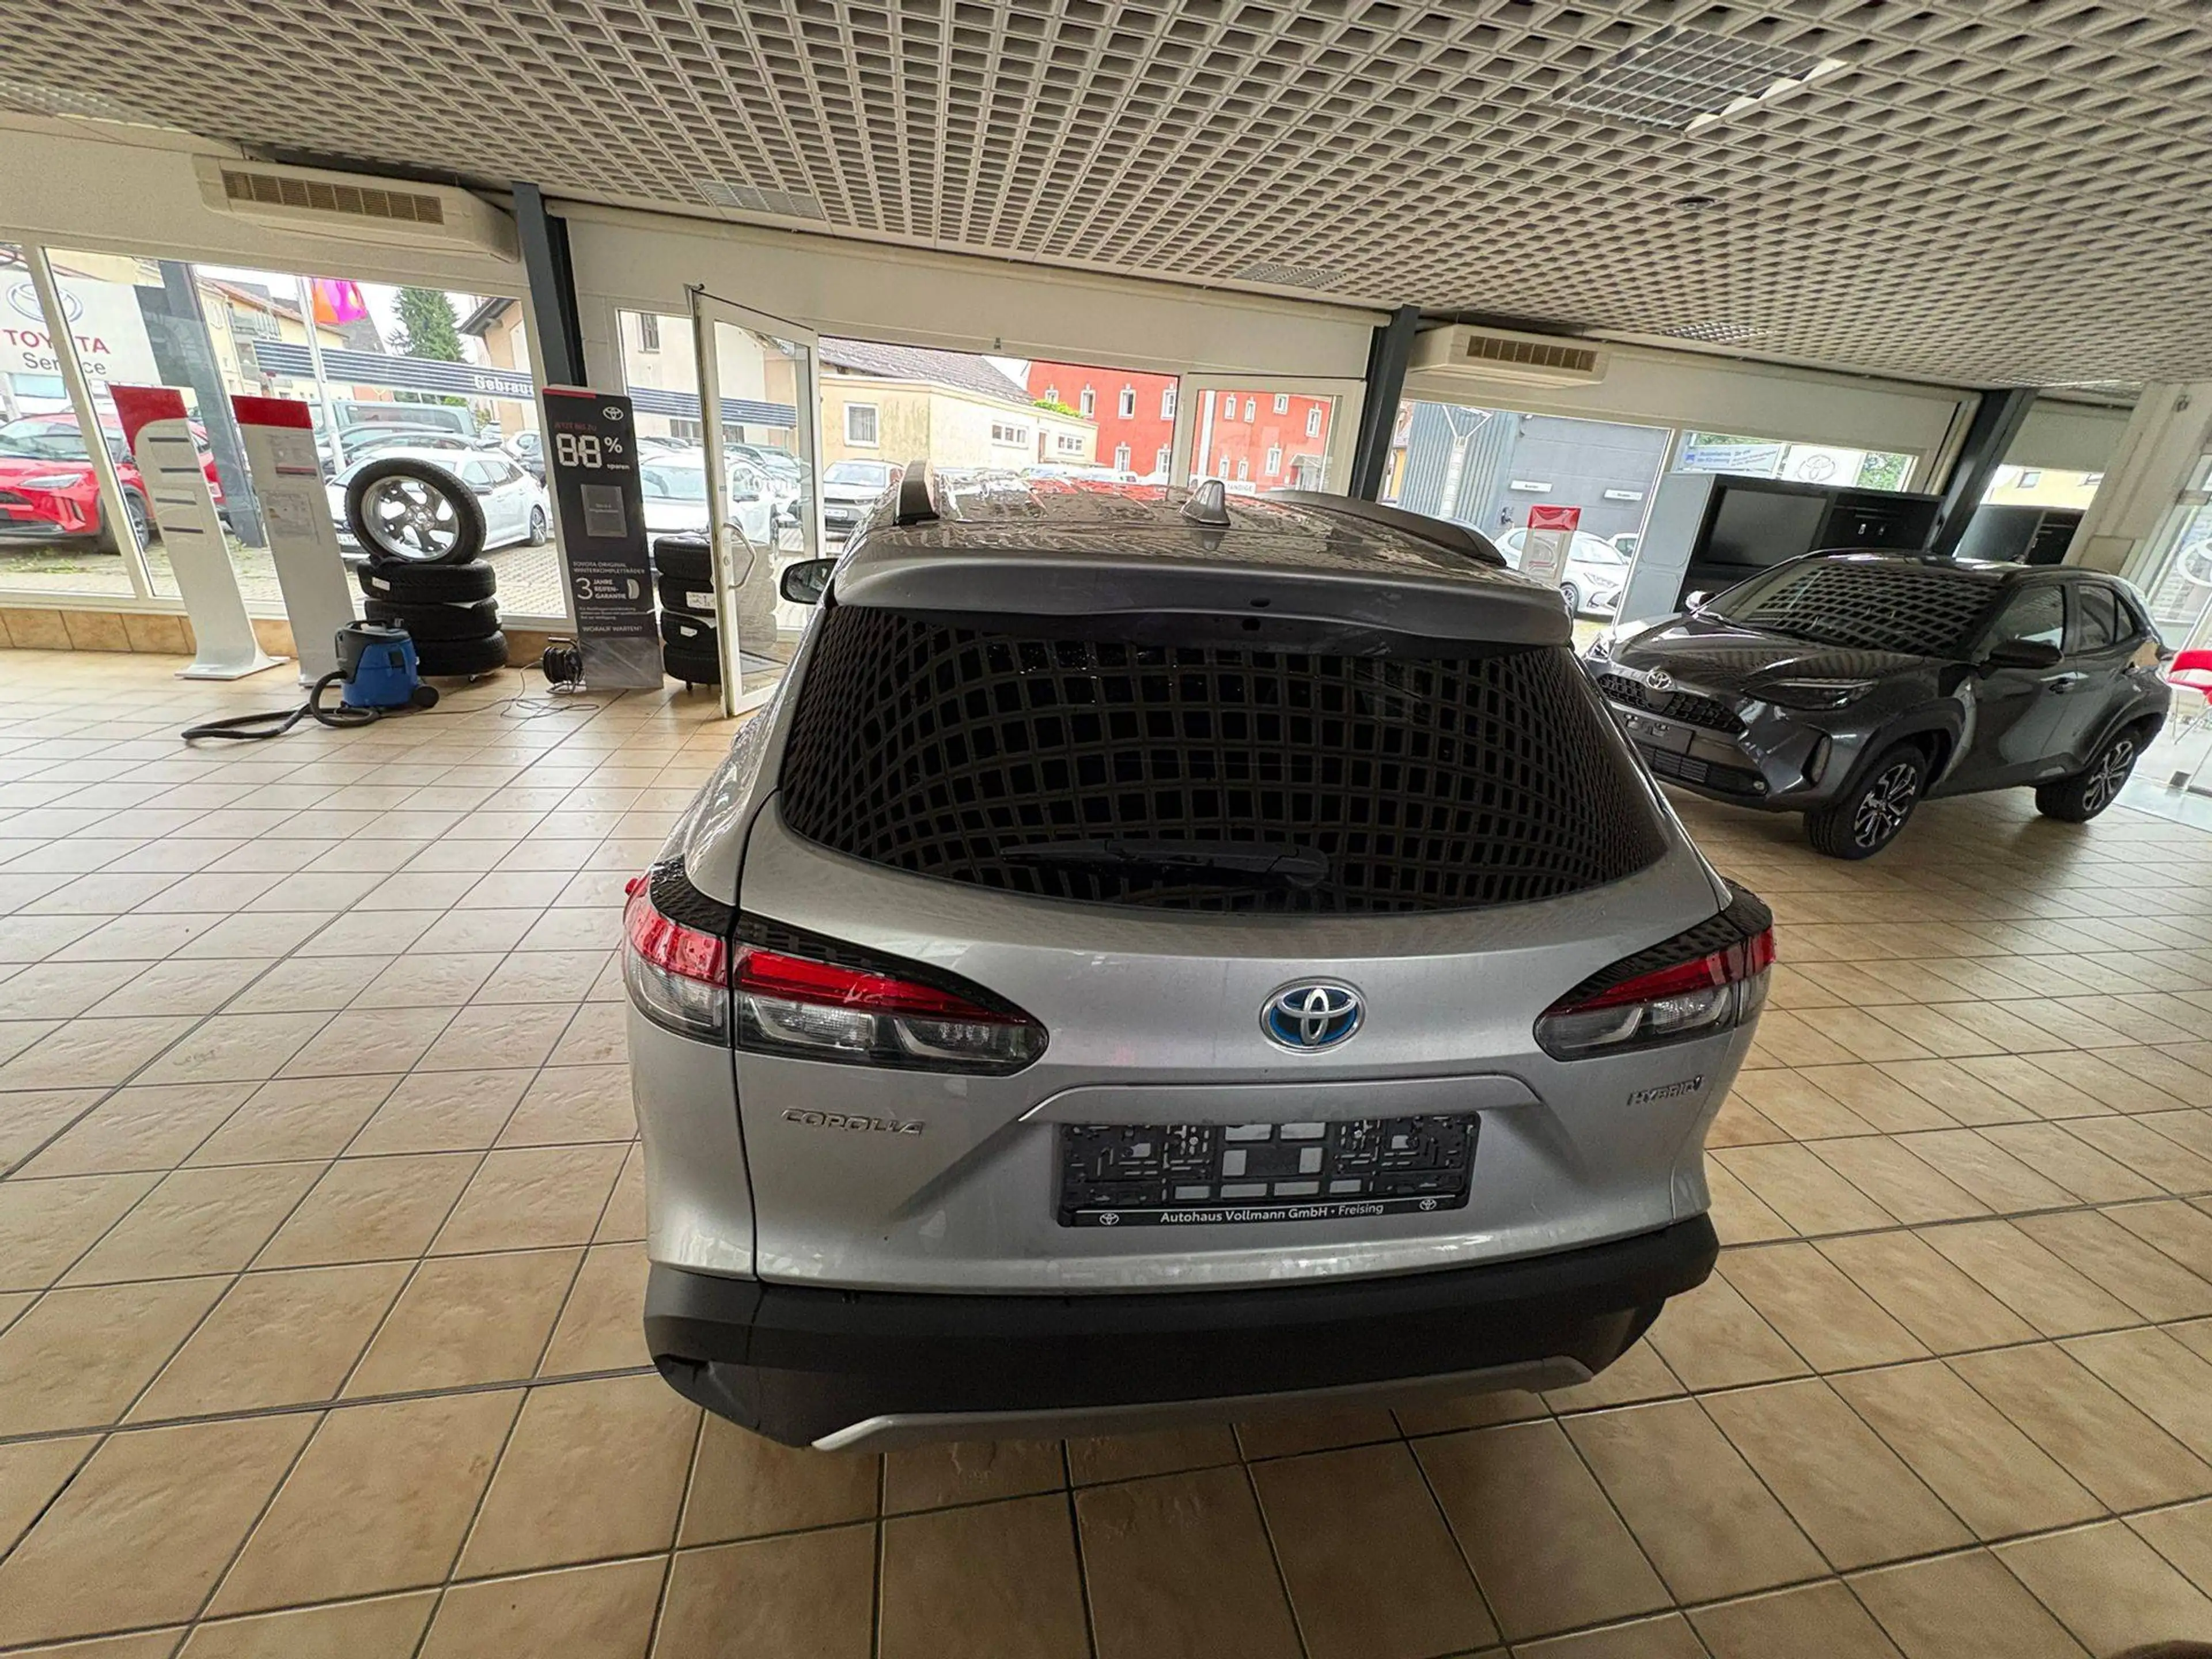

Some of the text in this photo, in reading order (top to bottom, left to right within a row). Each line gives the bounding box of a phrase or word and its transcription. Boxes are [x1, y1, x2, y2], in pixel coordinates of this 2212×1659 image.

[2, 329, 111, 354] TOYTA
[22, 351, 107, 374] Serce
[556, 433, 623, 468] 88 %
[575, 577, 593, 599] 3
[781, 1107, 926, 1137] COROLLA
[1160, 1203, 1384, 1224] Autohaus Vollmann GmbH Freising
